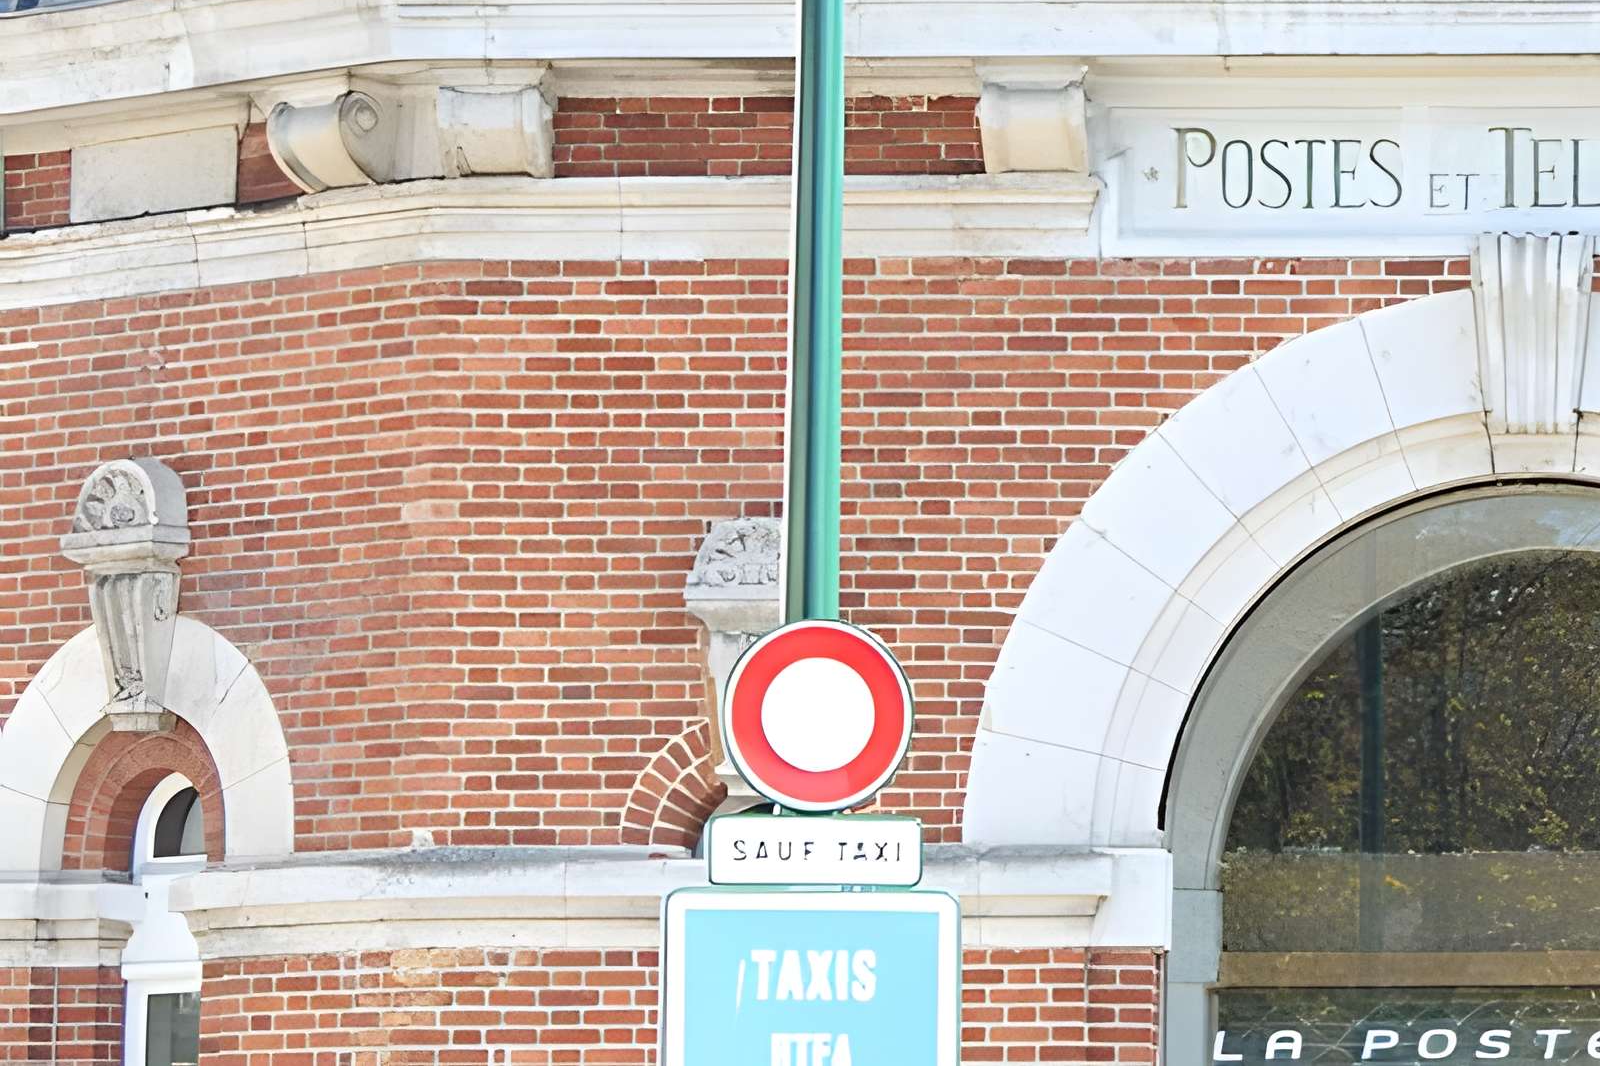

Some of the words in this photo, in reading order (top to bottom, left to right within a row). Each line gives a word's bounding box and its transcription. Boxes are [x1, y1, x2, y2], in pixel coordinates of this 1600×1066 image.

[1171, 126, 1403, 210] POSTES
[1428, 173, 1480, 211] ET
[733, 839, 815, 862] SAUF
[838, 841, 901, 862] TAXI
[750, 949, 877, 1002] TAXIS
[1213, 1029, 1303, 1061] LA
